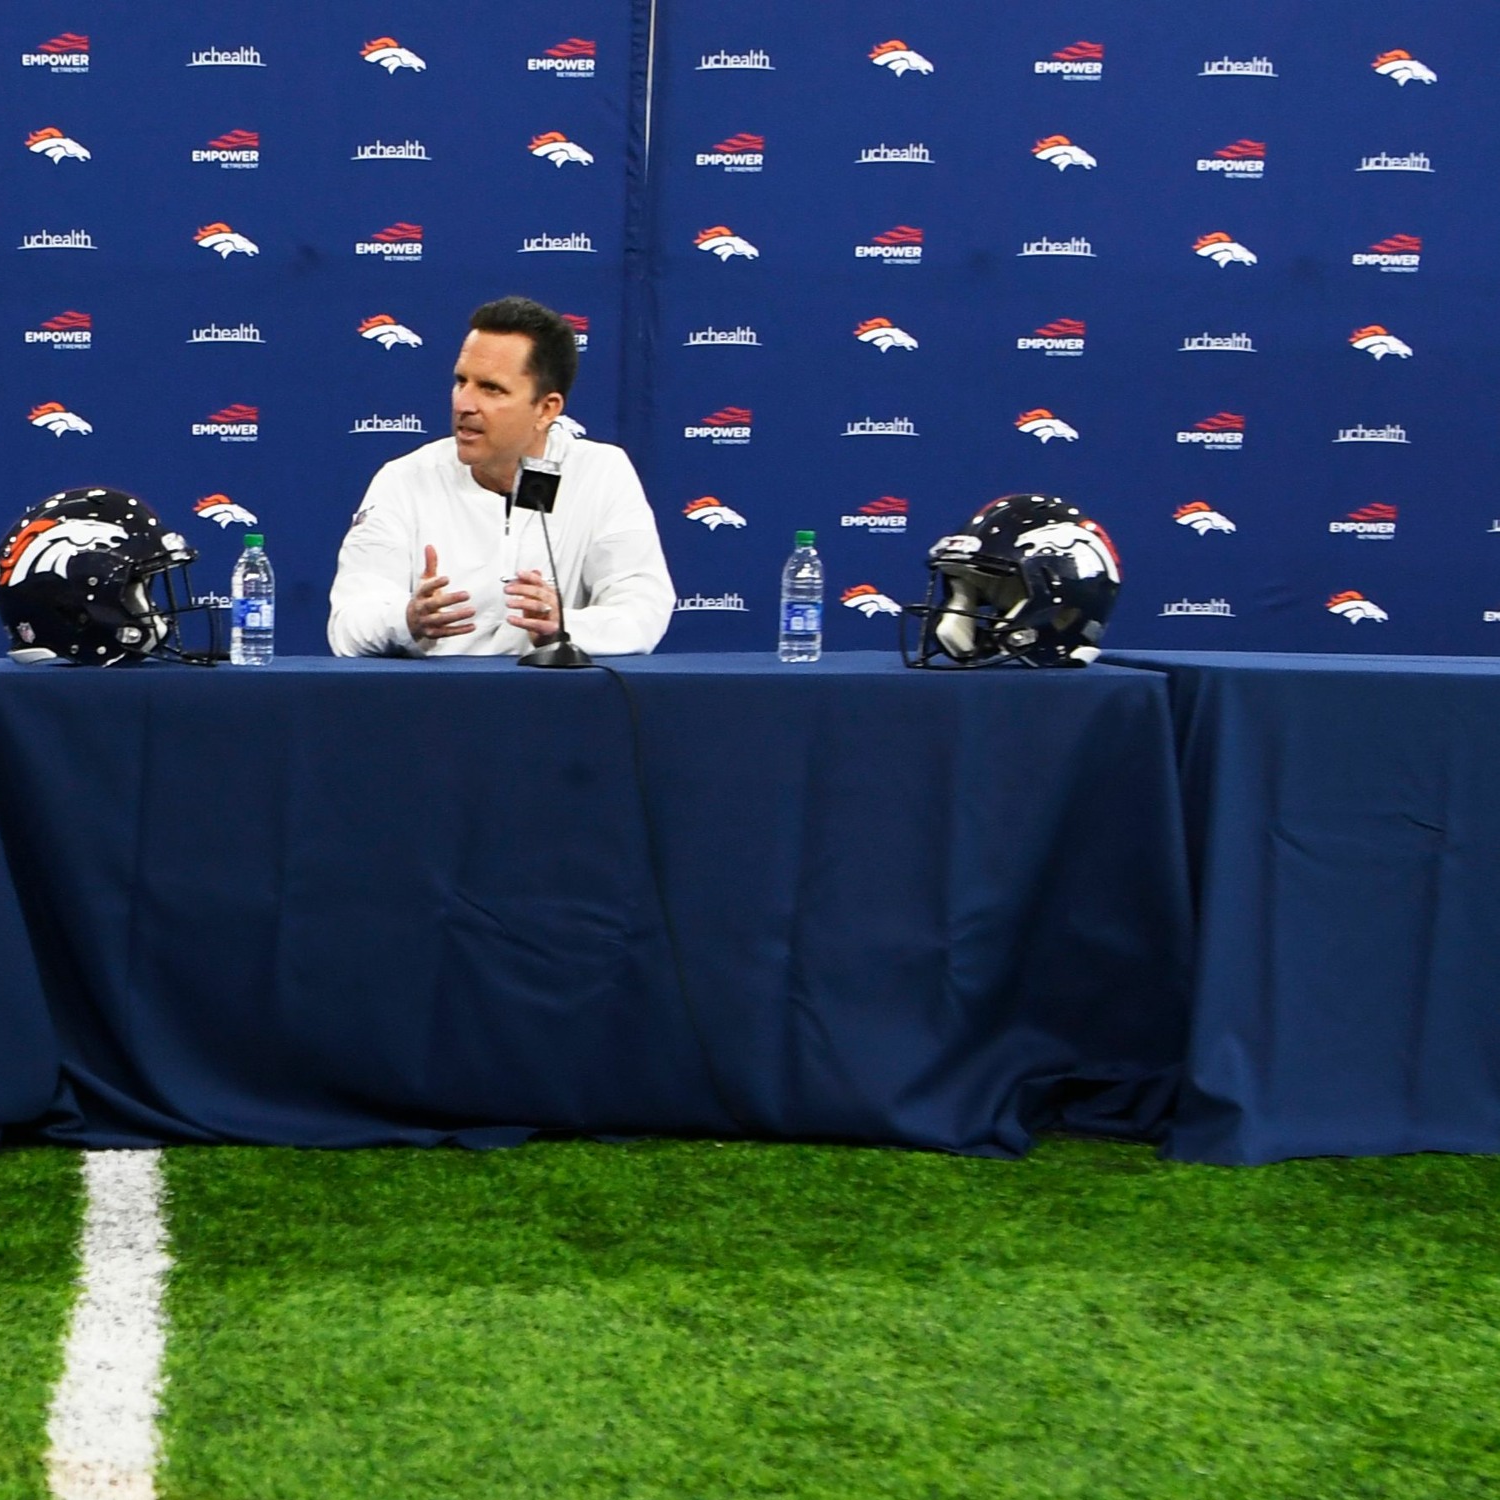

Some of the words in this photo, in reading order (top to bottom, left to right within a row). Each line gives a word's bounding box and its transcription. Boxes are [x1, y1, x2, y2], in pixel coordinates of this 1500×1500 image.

[21, 53, 90, 66] EMPOWER
[192, 45, 261, 63] uchealth
[701, 49, 770, 66] uchealth
[527, 58, 596, 71] EMPOWER
[1034, 61, 1103, 74] EMPOWER
[1204, 55, 1273, 74] uchealth
[191, 149, 260, 162] EMPOWER
[357, 139, 426, 157] uchealth
[861, 142, 930, 160] uchealth
[695, 153, 764, 166] EMPOWER
[1196, 159, 1265, 172] EMPOWER
[1361, 151, 1430, 169] uchealth
[23, 229, 92, 246] uchealth
[523, 232, 591, 249] uchealth
[1023, 236, 1092, 254] uchealth
[355, 242, 423, 255] EMPOWER
[854, 245, 923, 258] EMPOWER
[1351, 253, 1421, 266] EMPOWER
[24, 330, 92, 343] EMPOWER
[192, 323, 260, 339] uchealth
[689, 326, 757, 342] uchealth
[1017, 337, 1085, 350] EMPOWER
[1184, 332, 1252, 349] uchealth
[354, 413, 422, 430] uchealth
[847, 416, 914, 432] uchealth
[191, 423, 259, 436] EMPOWER
[684, 426, 752, 438] EMPOWER
[1338, 423, 1406, 440] uchealth
[1176, 431, 1244, 444] EMPOWER
[840, 515, 908, 527] EMPOWER
[1328, 521, 1396, 534] EMPOWER
[677, 593, 745, 609] uchealth
[1164, 598, 1231, 613] uchealth
